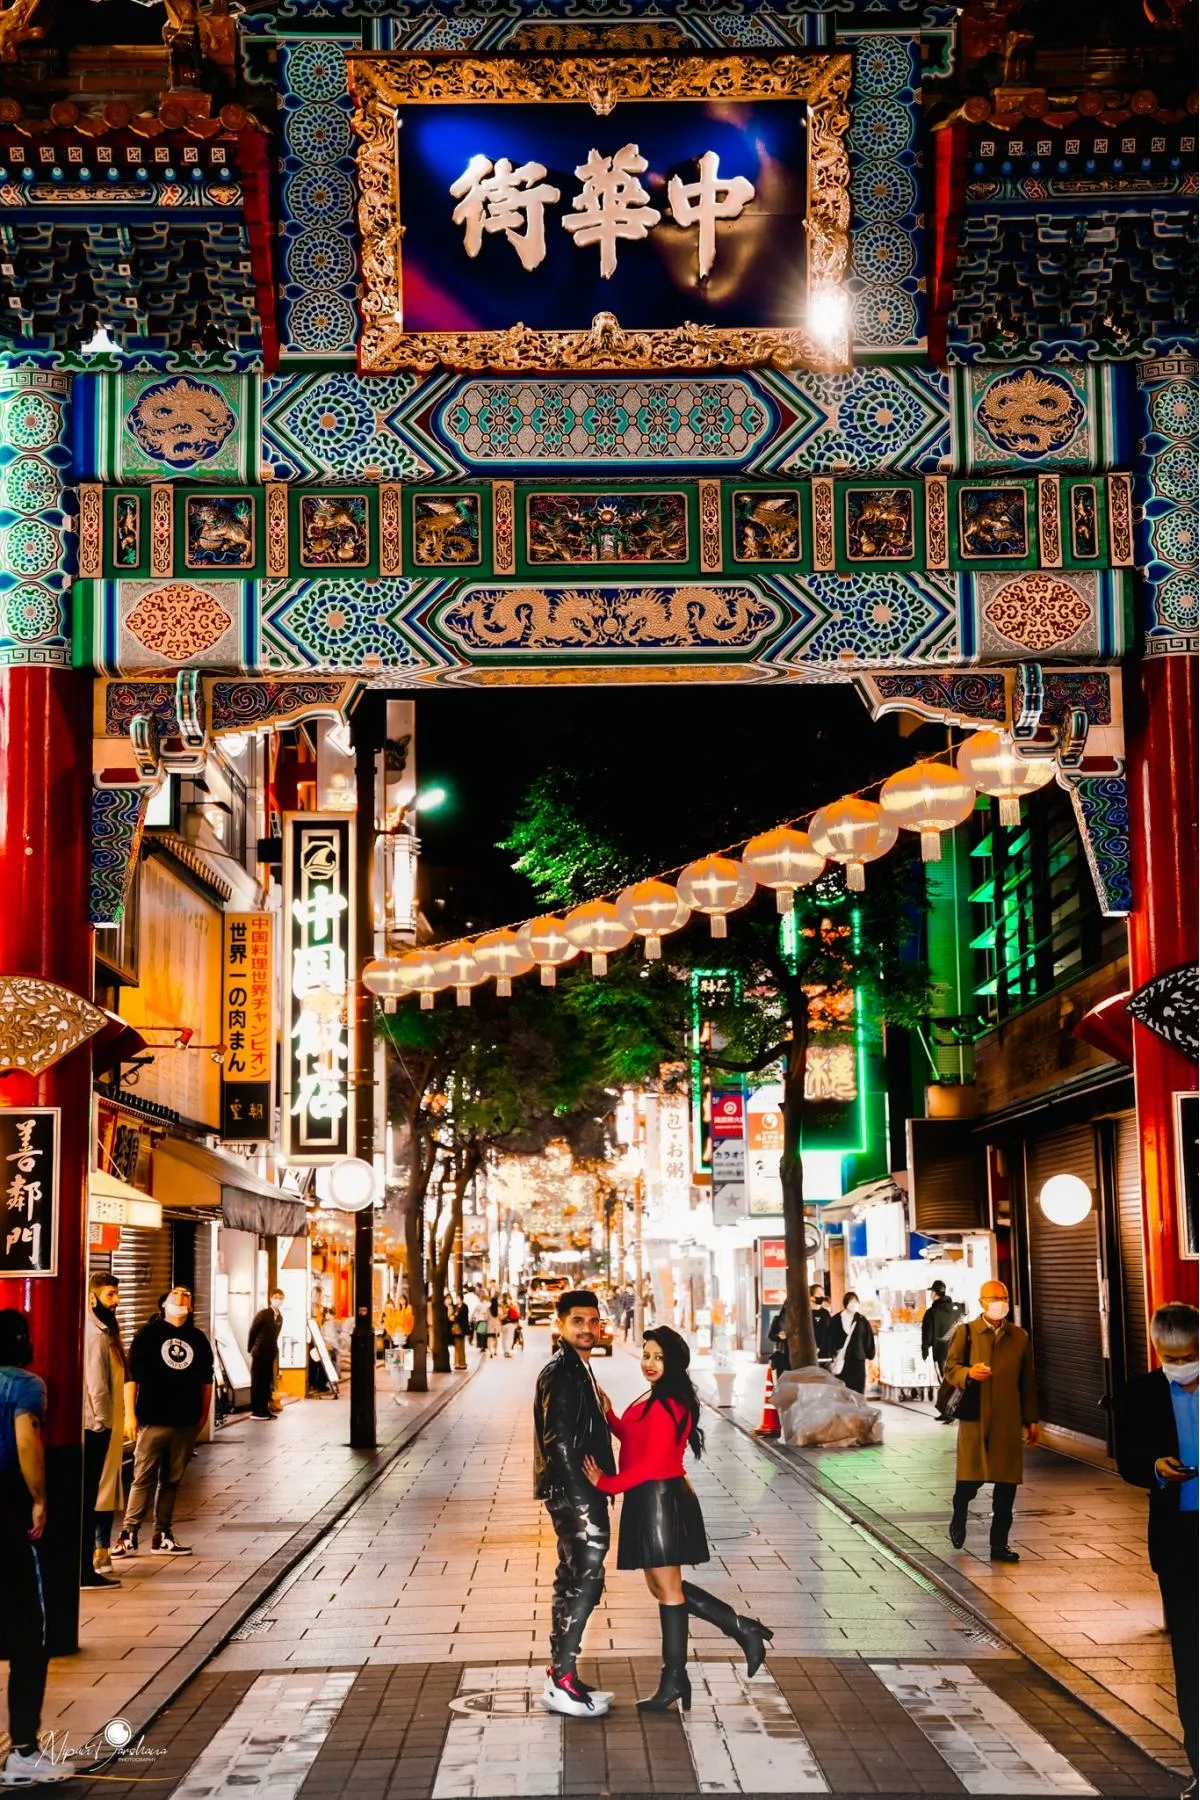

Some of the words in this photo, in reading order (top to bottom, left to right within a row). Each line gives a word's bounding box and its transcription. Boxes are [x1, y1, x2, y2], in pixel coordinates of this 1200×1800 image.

[228, 922, 247, 1074] 世界一の肉まん
[250, 916, 268, 1079] 中国料理世界チャンピオン
